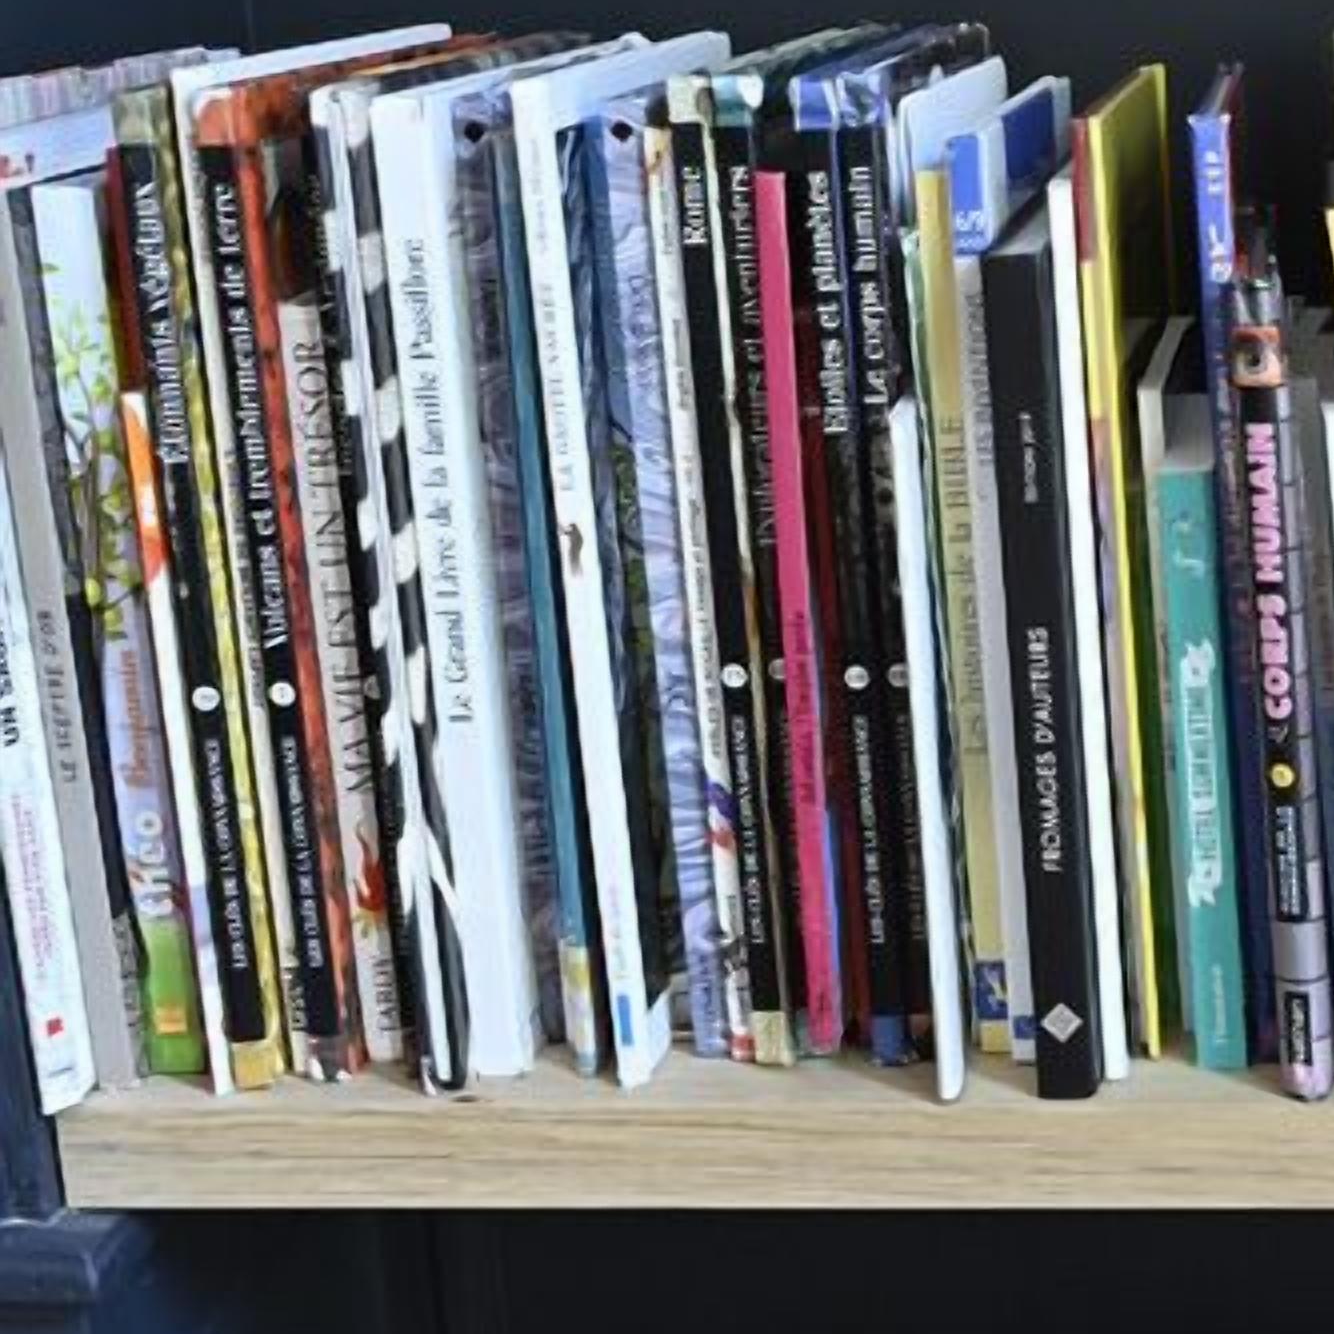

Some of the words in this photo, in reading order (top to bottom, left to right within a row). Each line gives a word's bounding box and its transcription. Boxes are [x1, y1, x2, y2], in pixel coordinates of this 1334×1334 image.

[680, 165, 708, 244] Rome
[847, 165, 878, 270] humain
[219, 264, 246, 297] de
[815, 301, 842, 328] et
[858, 279, 887, 358] corps
[411, 371, 445, 454] famille
[861, 368, 890, 403] Le
[421, 465, 448, 486] la
[1244, 422, 1285, 582] HUMAIN
[251, 508, 275, 535] et
[311, 510, 346, 566] UN
[424, 498, 451, 526] de
[433, 539, 460, 596] Livre
[433, 611, 468, 682] Grand
[1256, 592, 1292, 718] CORPS
[449, 694, 473, 721] Le
[1025, 625, 1055, 743] D'AUTEURS
[1034, 749, 1064, 871] FROMAGES
